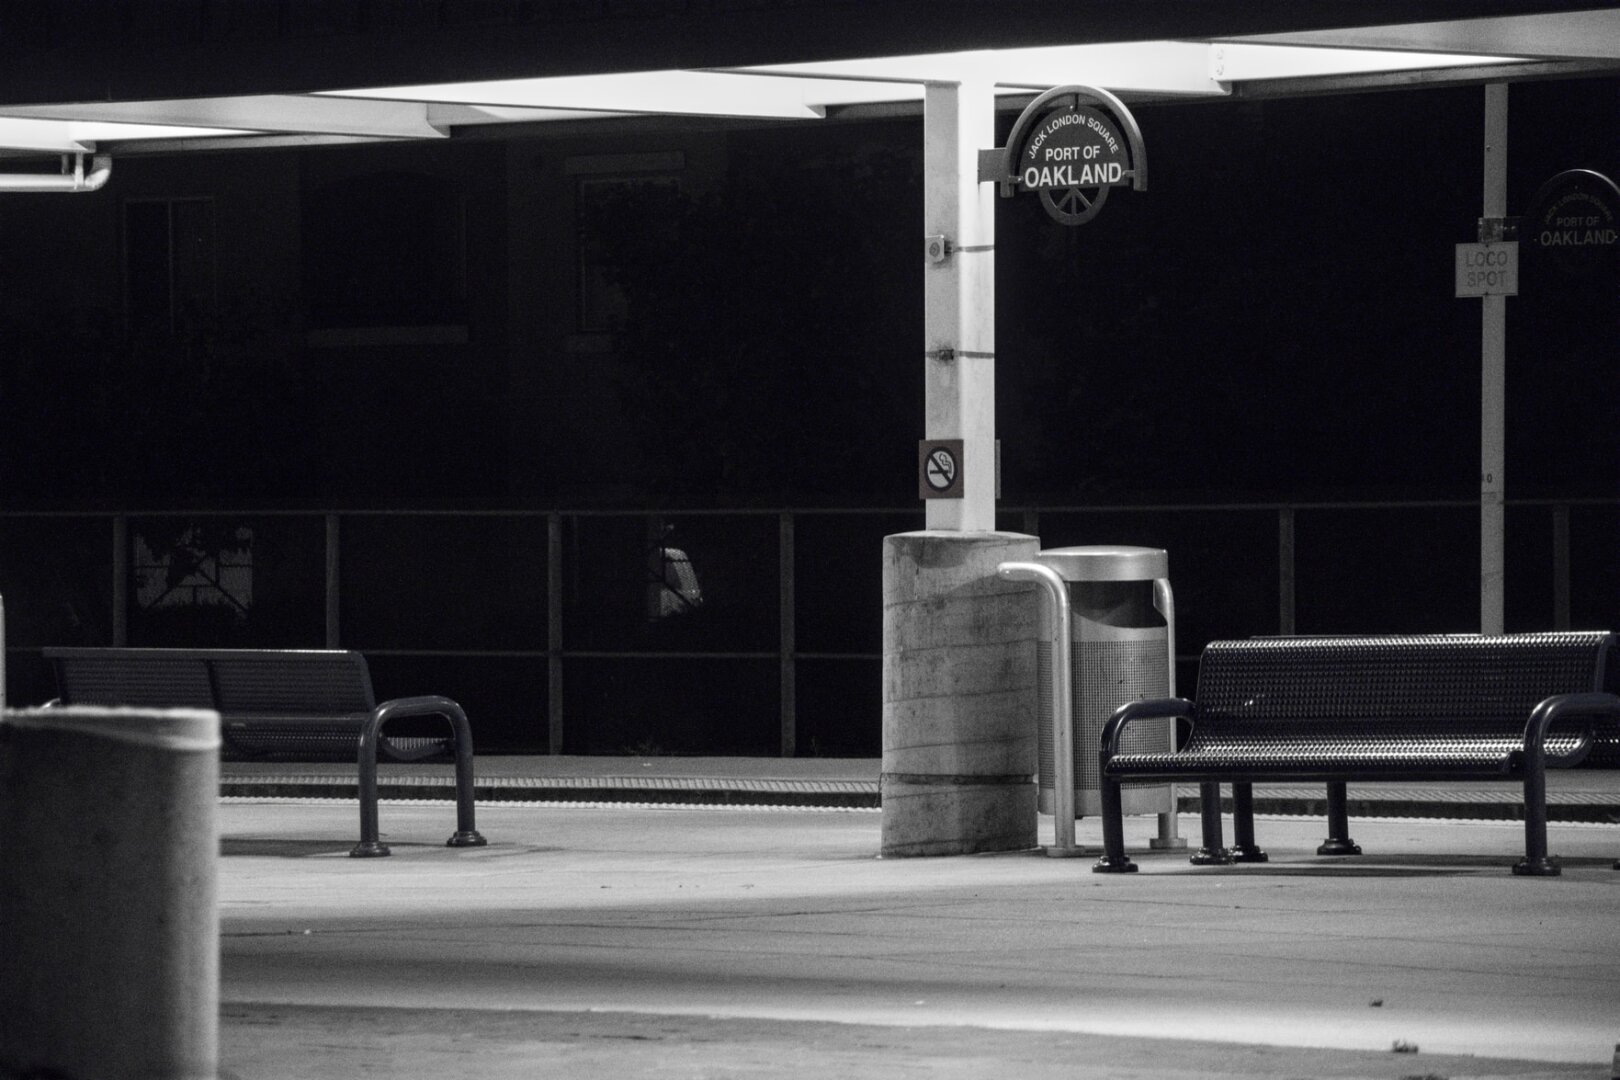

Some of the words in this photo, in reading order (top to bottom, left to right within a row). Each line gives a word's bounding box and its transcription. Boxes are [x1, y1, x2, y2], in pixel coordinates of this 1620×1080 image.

[1028, 130, 1047, 159] JACK
[1046, 114, 1086, 134] LONDON
[1087, 117, 1119, 154] SQUARE
[1045, 147, 1080, 161] PORT
[1083, 145, 1101, 160] OF
[1025, 162, 1122, 188] OAKLAND
[1556, 216, 1585, 228] PORT
[1585, 215, 1600, 227] OF
[1540, 229, 1616, 247] OAKLAND
[1466, 251, 1508, 267] LOCO
[1467, 270, 1507, 288] SPOT
